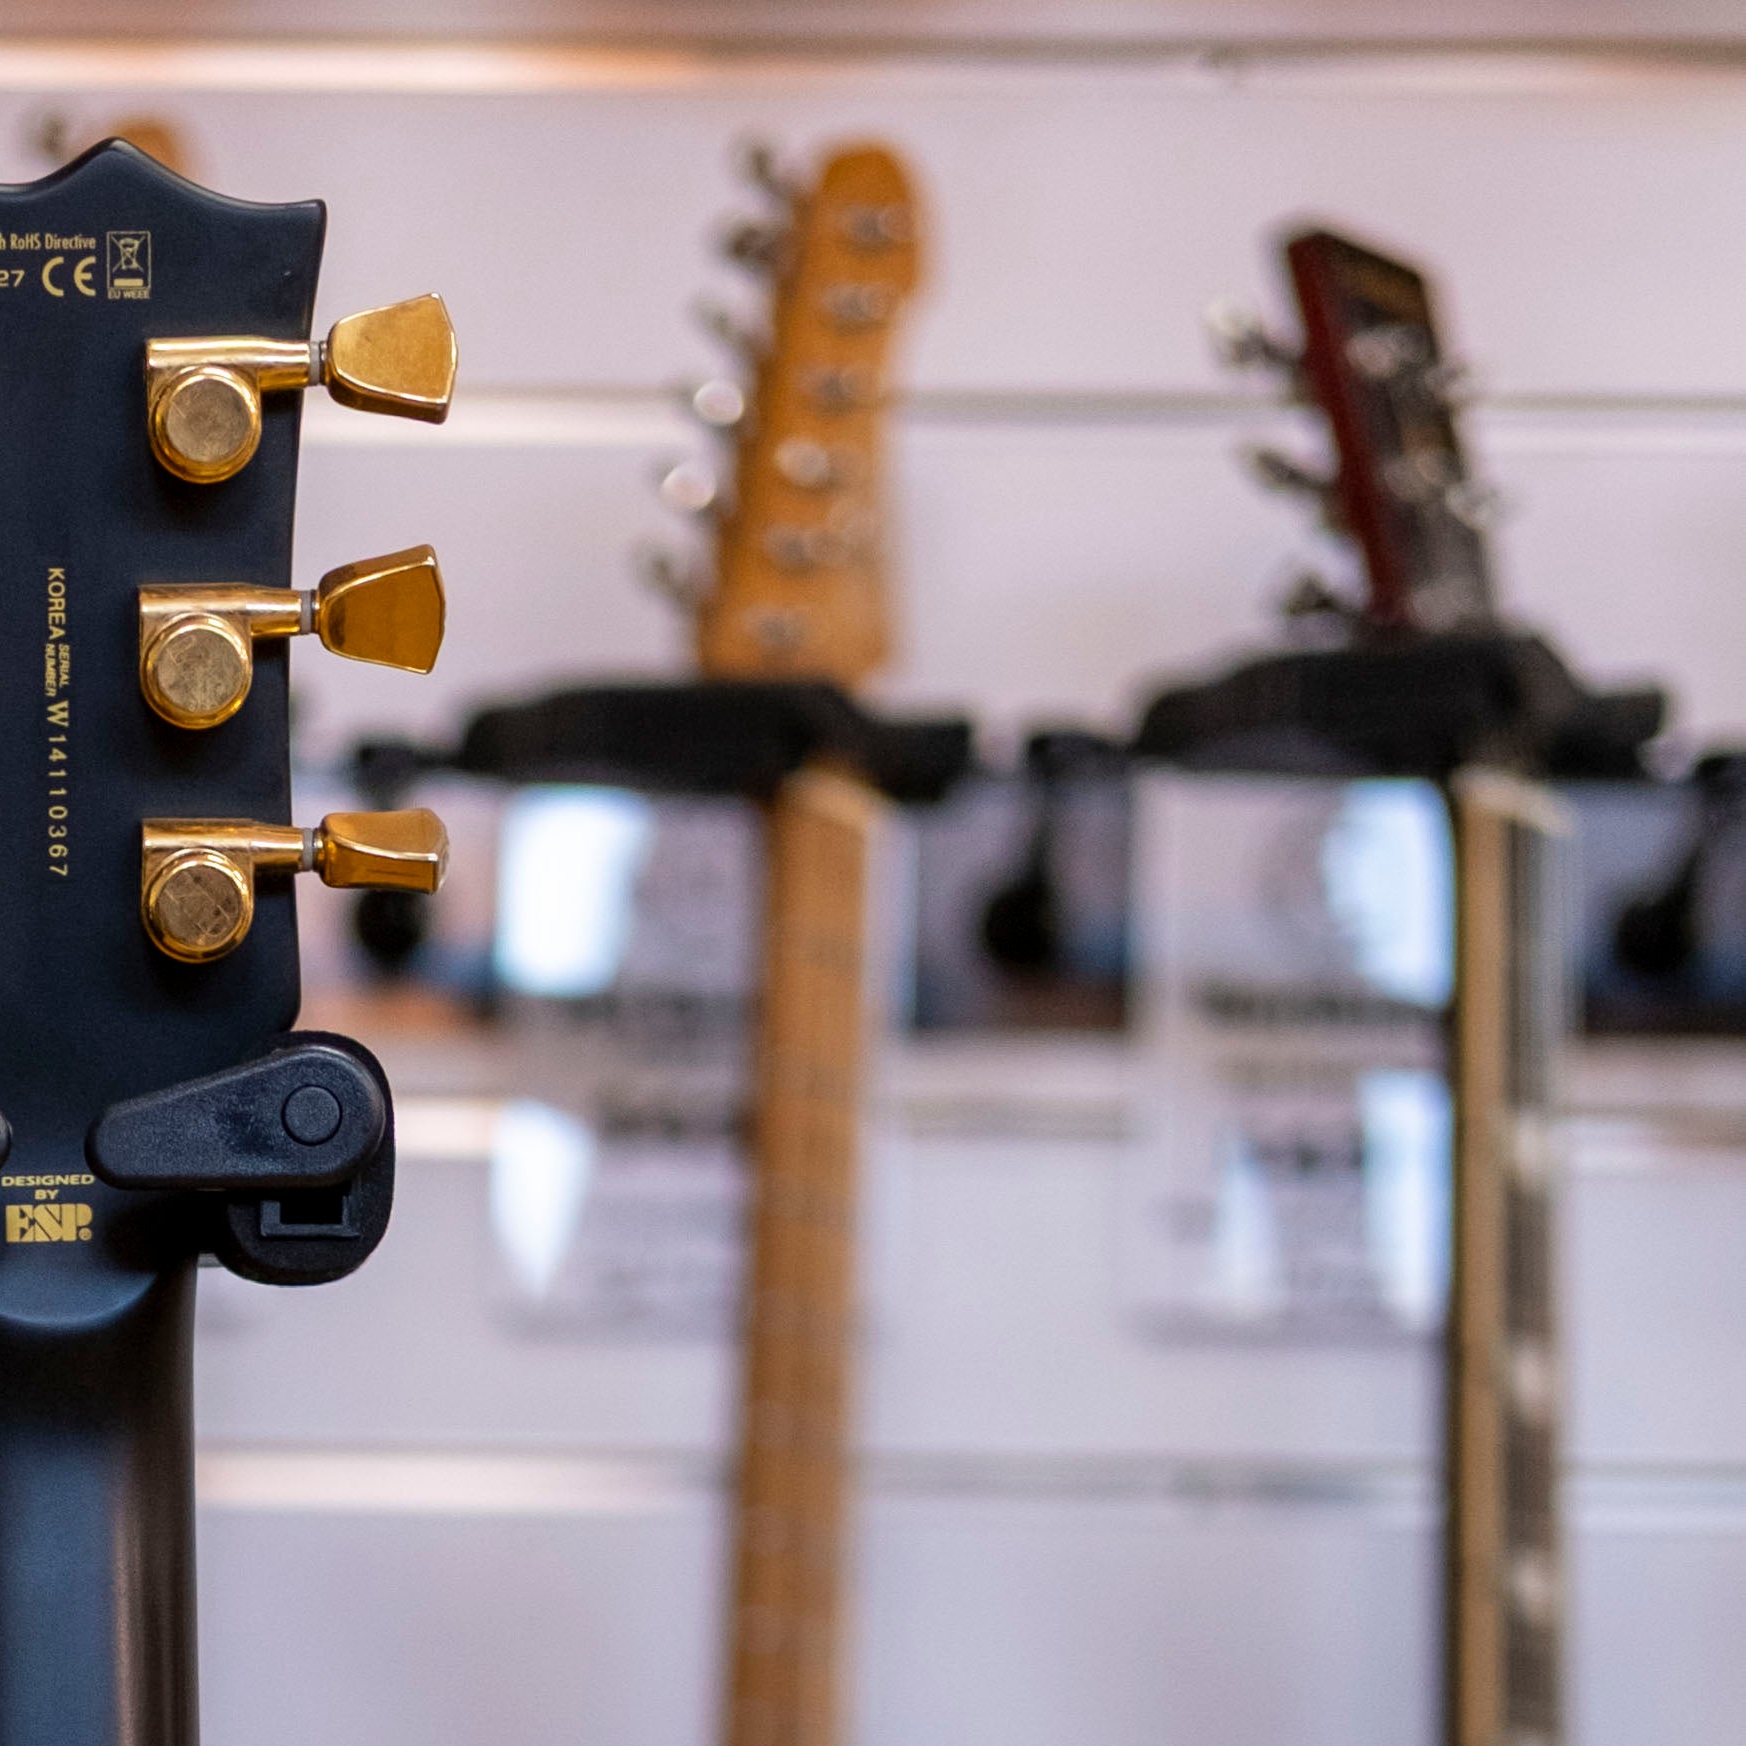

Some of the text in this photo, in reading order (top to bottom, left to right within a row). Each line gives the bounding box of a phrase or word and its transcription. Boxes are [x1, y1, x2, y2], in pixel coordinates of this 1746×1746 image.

[10, 232, 41, 251] RoHS
[44, 232, 97, 251] Directive
[47, 567, 66, 640] KOREA
[44, 643, 58, 698] NUMBER
[58, 643, 71, 688] SERIAL
[1, 1174, 95, 1188] DESIGNED
[34, 1188, 60, 1200] BY
[5, 1202, 93, 1243] ESP
